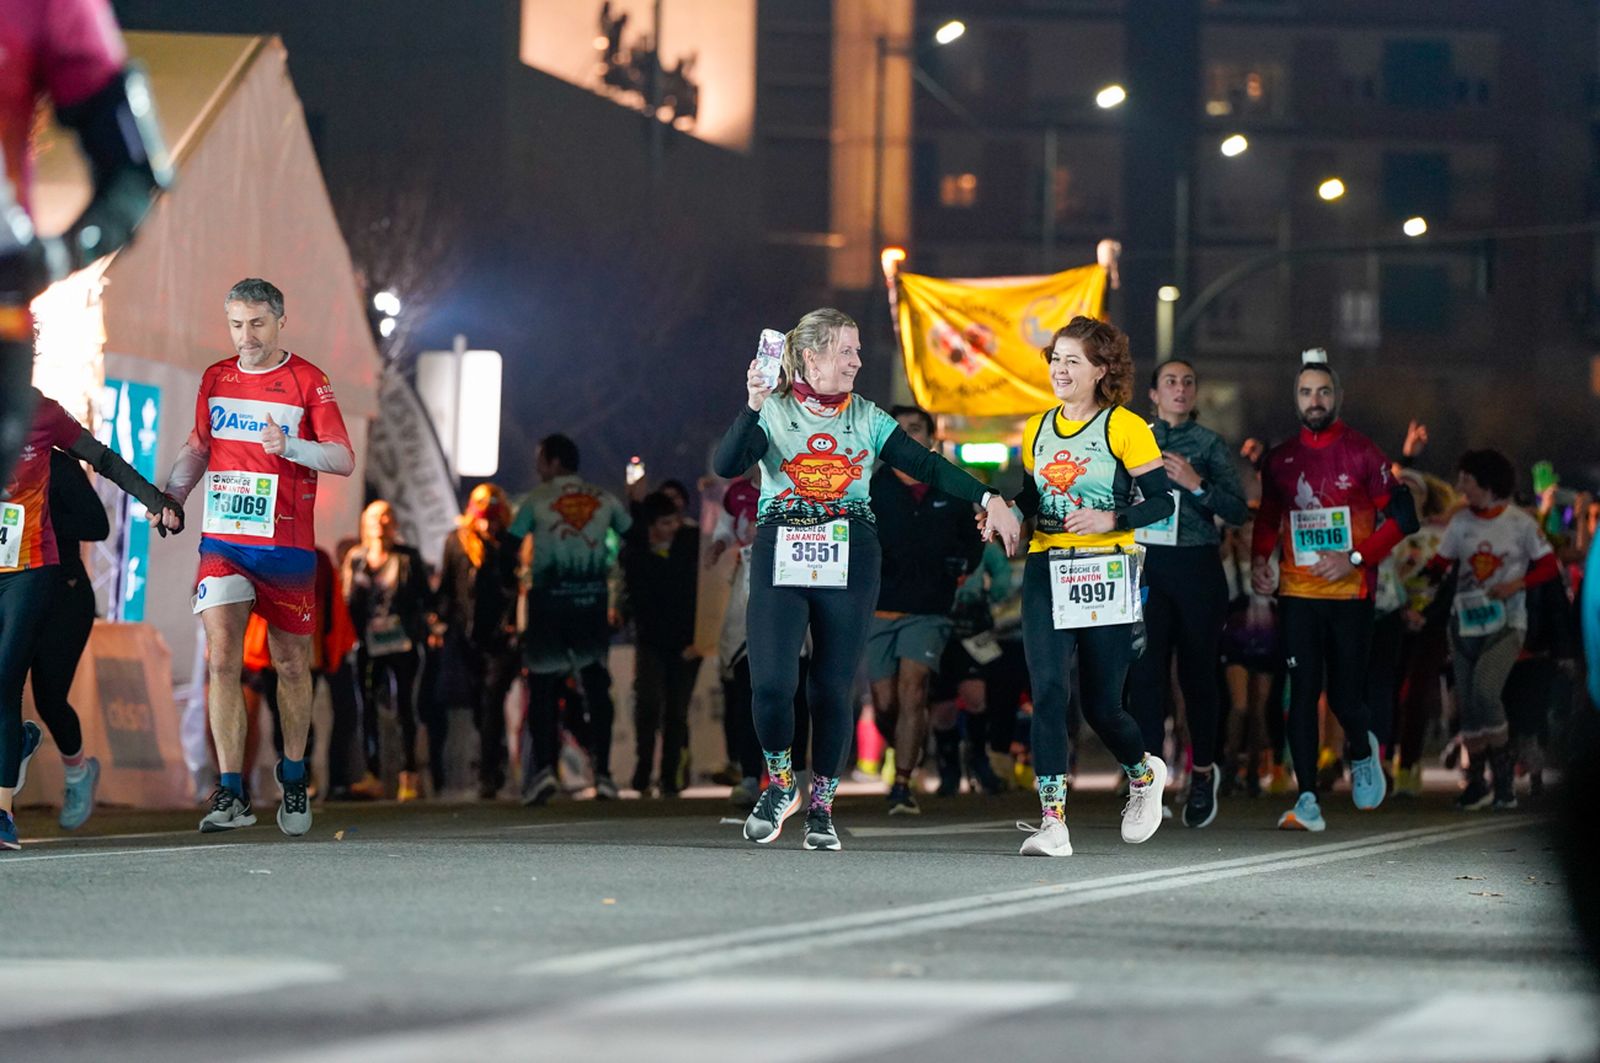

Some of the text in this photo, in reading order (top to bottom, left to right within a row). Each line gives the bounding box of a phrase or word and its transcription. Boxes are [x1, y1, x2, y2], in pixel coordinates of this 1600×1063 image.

[225, 413, 290, 435] Avana
[785, 533, 800, 541] SAN
[1299, 528, 1343, 546] 13616
[791, 541, 839, 563] 3551
[1092, 565, 1101, 573] DE
[1060, 575, 1076, 584] SAN
[1069, 581, 1115, 604] 4997
